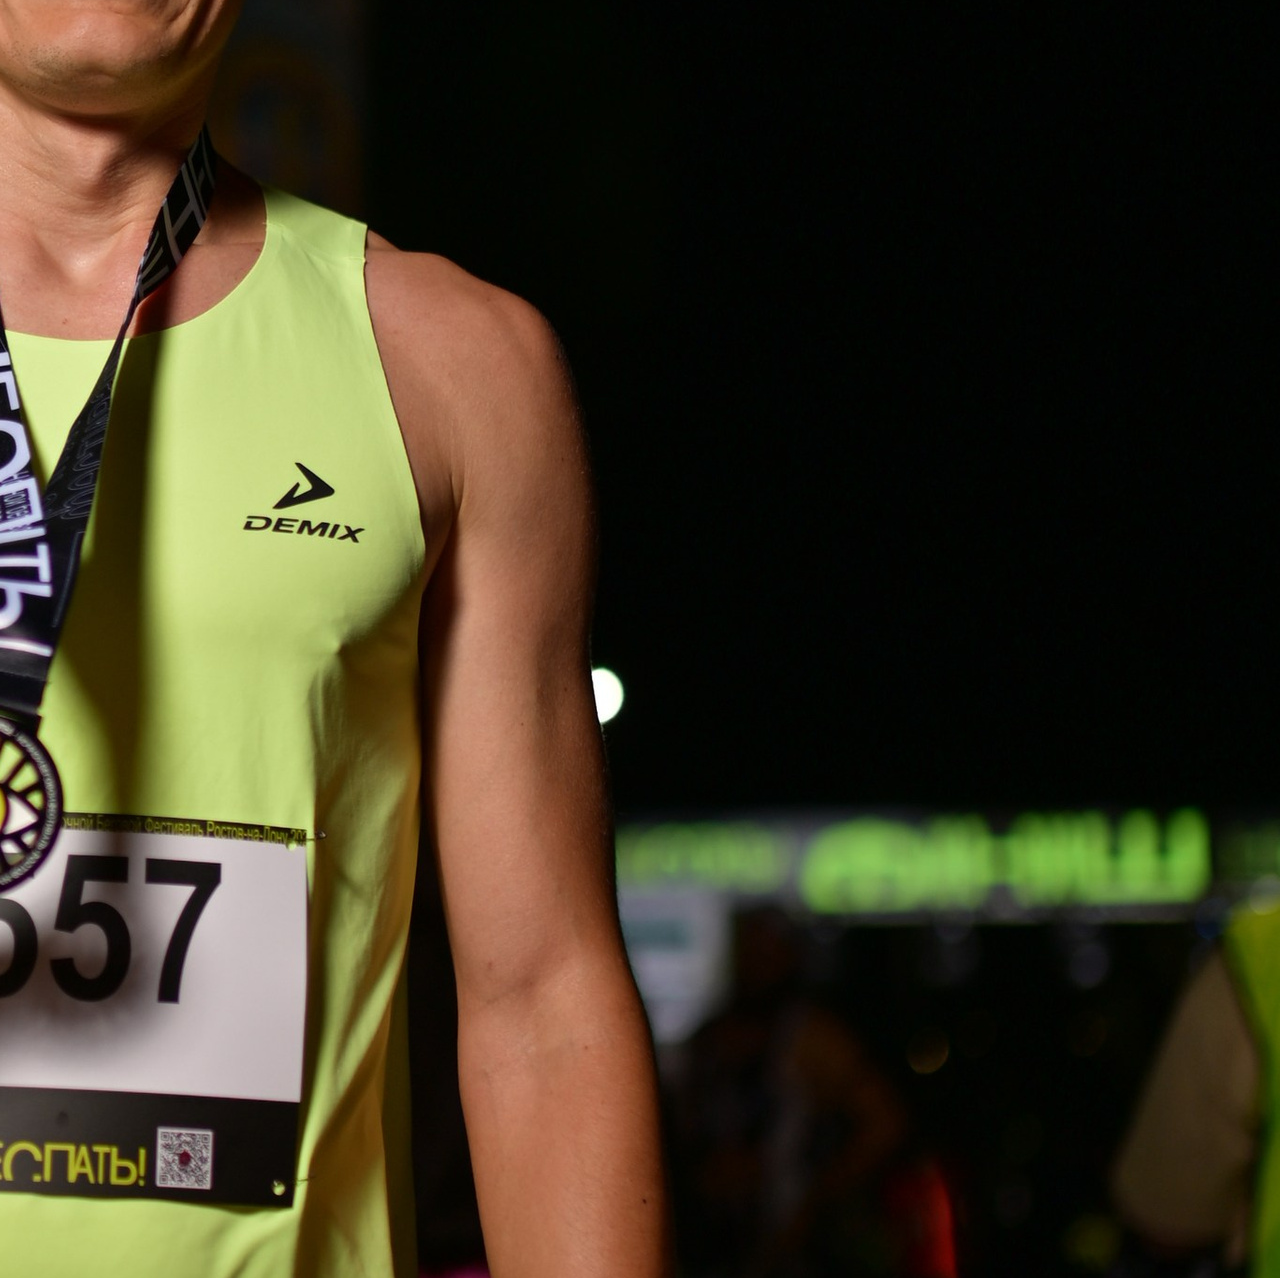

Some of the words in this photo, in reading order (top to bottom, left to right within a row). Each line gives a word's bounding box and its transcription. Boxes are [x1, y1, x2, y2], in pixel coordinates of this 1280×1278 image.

[243, 515, 365, 543] DEMIX
[61, 814, 94, 830] чной
[144, 816, 204, 837] Фестиваль
[206, 821, 288, 845] Ростов-на-Дону
